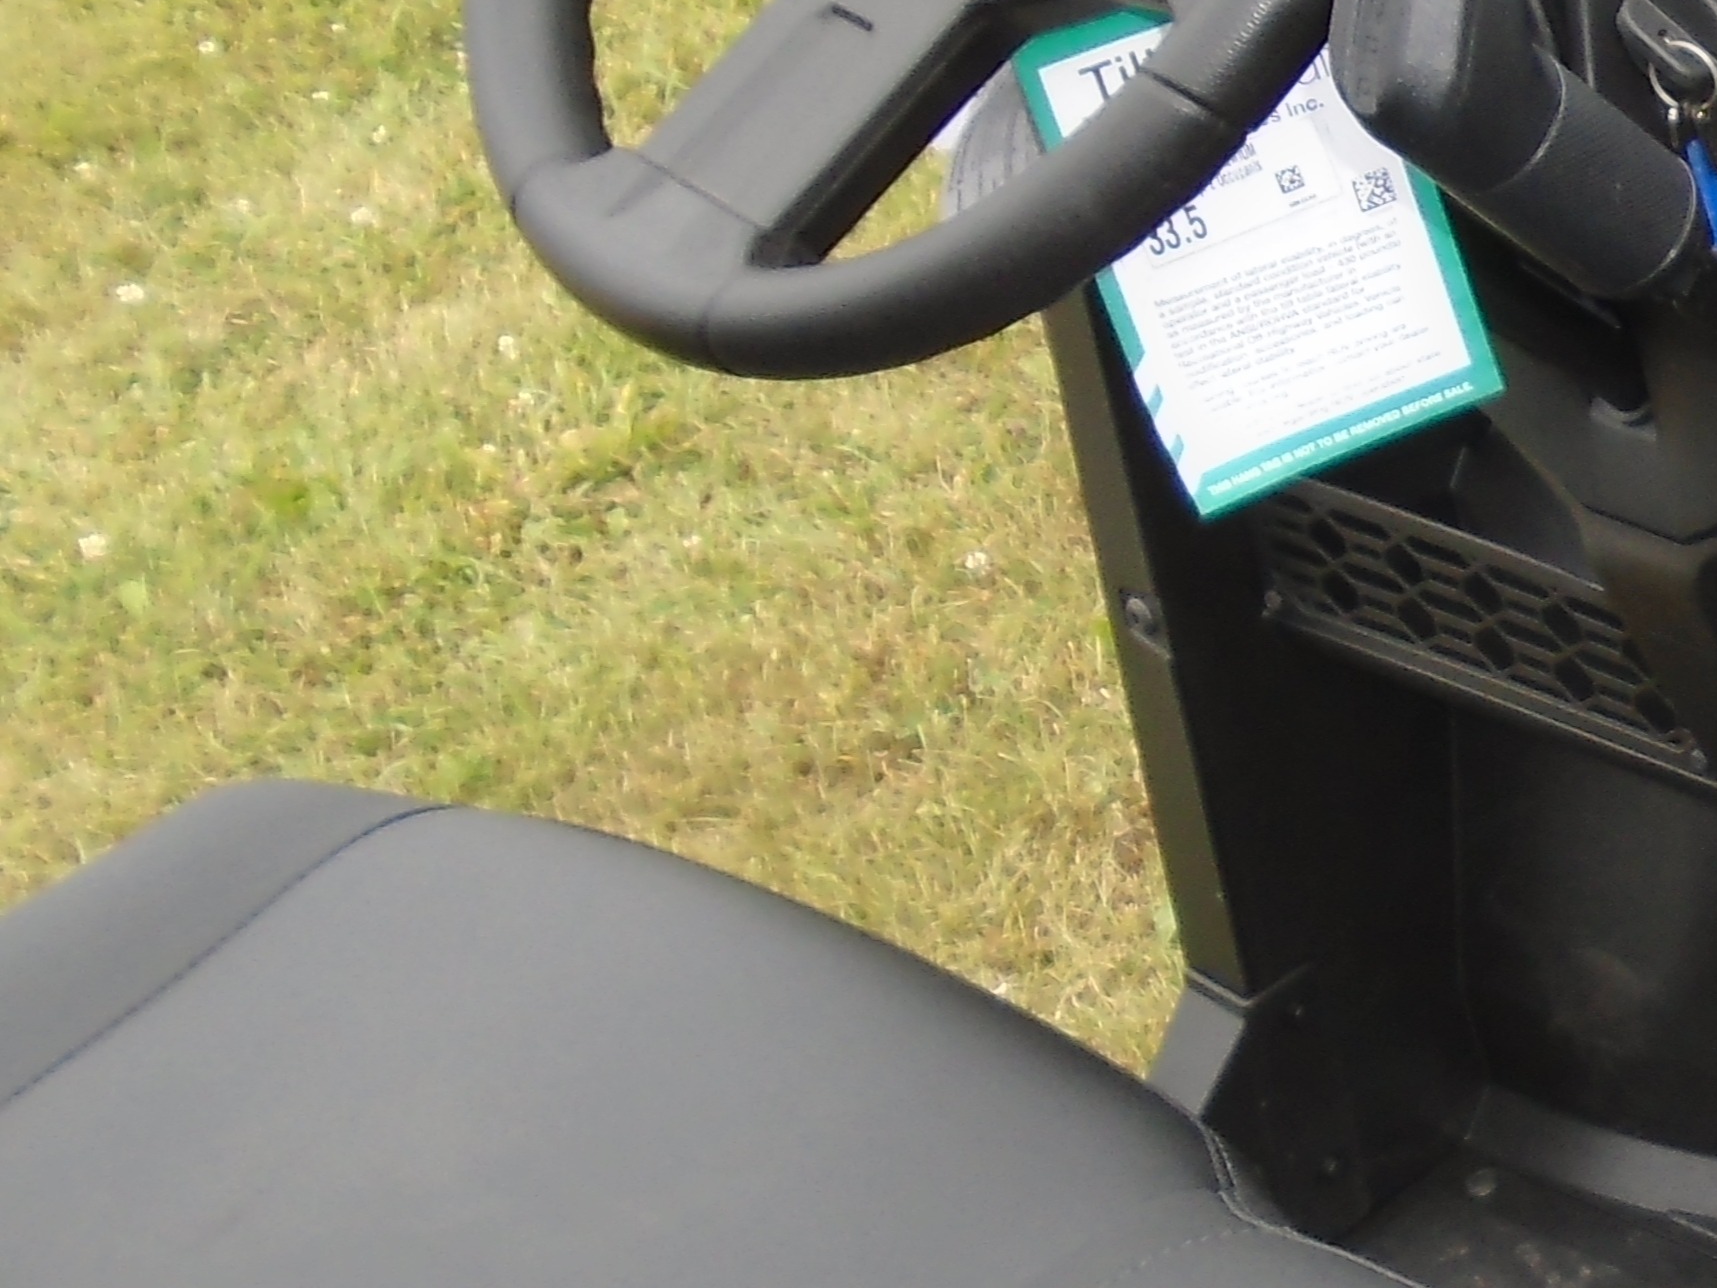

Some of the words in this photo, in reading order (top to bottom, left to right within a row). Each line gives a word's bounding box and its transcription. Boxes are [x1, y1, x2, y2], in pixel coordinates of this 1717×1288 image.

[1285, 96, 1324, 118] Inc.
[1293, 441, 1317, 460] NOT
[1317, 437, 1333, 449] TO
[1349, 410, 1400, 436] REMOVED
[1402, 392, 1443, 415] BEFORE
